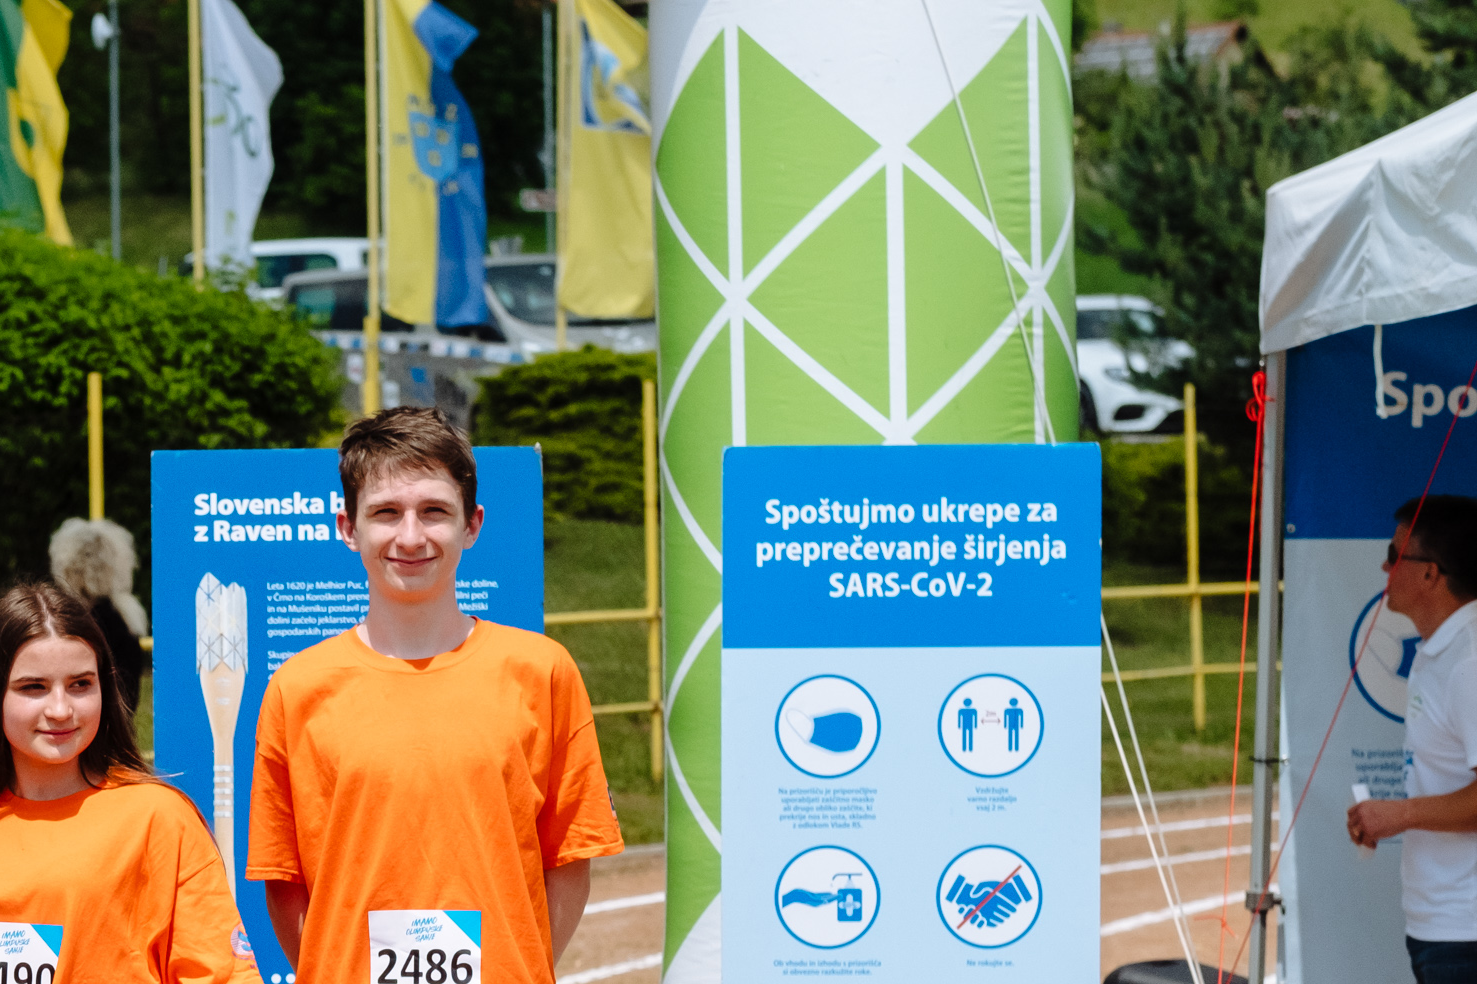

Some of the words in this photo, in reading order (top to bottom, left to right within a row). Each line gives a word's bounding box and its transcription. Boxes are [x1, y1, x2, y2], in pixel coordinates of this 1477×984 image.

[193, 491, 324, 516] Slovenska
[765, 497, 915, 530] Spoštujmo
[922, 496, 1020, 529] ukrepe
[1026, 502, 1058, 522] za
[193, 525, 209, 542] z
[213, 520, 292, 542] Raven
[297, 523, 330, 541] na
[756, 534, 957, 567] preprečevanje
[964, 533, 1067, 567] širjenja
[266, 581, 284, 590] Leta
[286, 581, 306, 590] 1620
[306, 581, 314, 592] je
[828, 572, 994, 598] SARS-CoV-2
[306, 593, 346, 601] Koroškem
[328, 604, 359, 614] postavil
[267, 615, 290, 624] dolini
[291, 615, 317, 624] začelo
[266, 627, 321, 638] gospodarskih
[267, 650, 298, 660] Skupin
[411, 916, 438, 927] IMAMO
[1, 930, 26, 939] IMAMO
